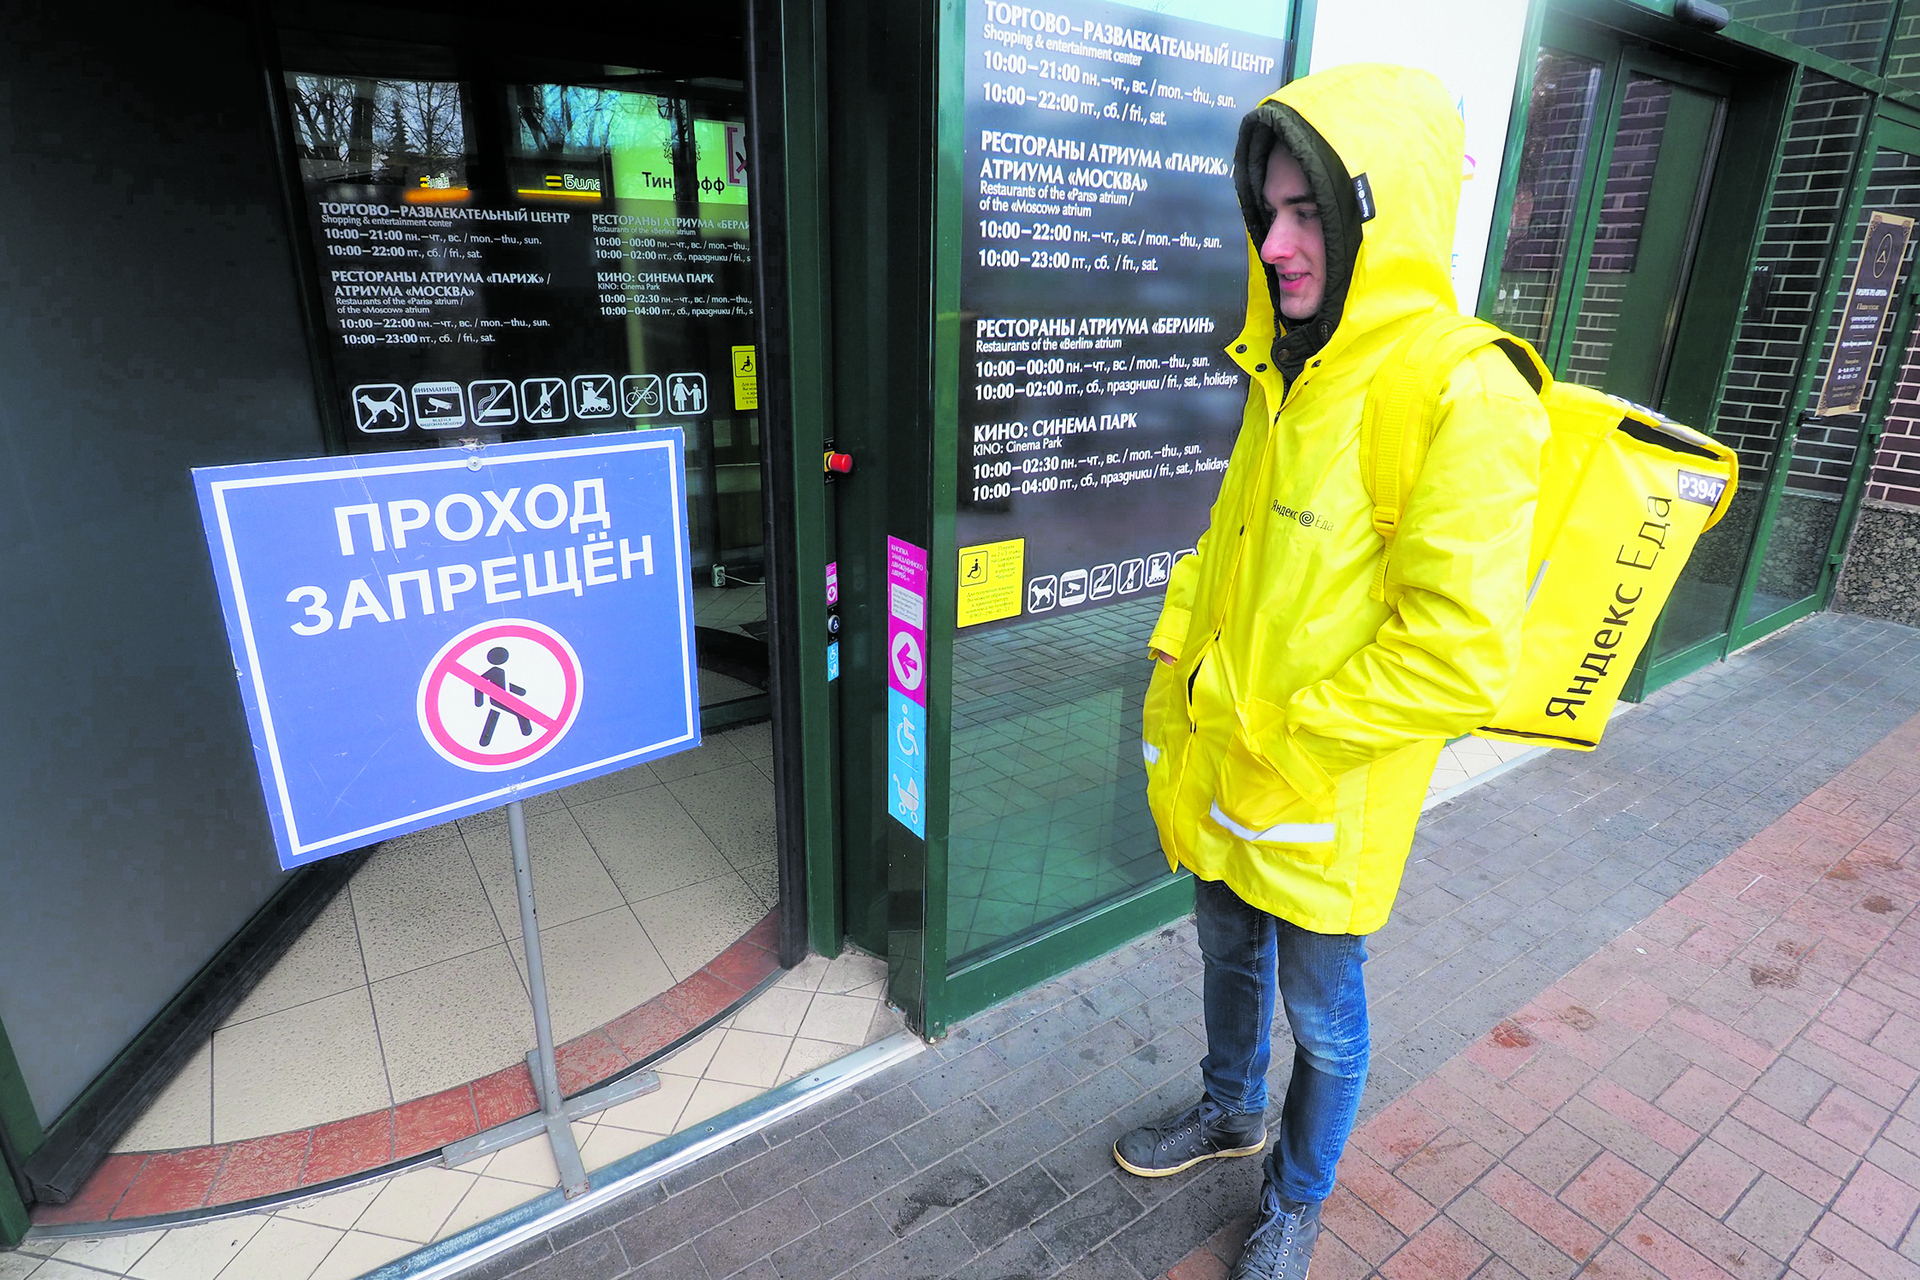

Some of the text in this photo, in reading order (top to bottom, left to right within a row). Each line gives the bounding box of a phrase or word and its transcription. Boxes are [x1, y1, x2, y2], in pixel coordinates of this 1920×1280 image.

[984, 24, 1142, 66] Shopping & entertainment center
[985, 0, 1274, 75] ТОРГОВО–РАЗВЛЕКАТЕЛЬНЫЙ ЦЕНТР
[984, 50, 1080, 83] 10:00–21:00
[1132, 80, 1148, 94] вс.
[1217, 95, 1236, 108] sun.
[983, 81, 1167, 126] 10:00–22:00 пт., сб. fri., sat.
[981, 130, 1228, 175] РЕСТОРАНЫ АТРИУМА «ПАРИЖ»
[642, 172, 725, 195] Тинфф
[980, 158, 1148, 191] АТРИУМА «МОСКВА»
[980, 180, 1036, 198] Restaurants
[1038, 185, 1049, 199] of
[1050, 185, 1065, 200] the
[1099, 191, 1127, 205] atrium
[531, 212, 570, 223] ЦЕНТР
[979, 199, 990, 211] of
[992, 199, 1009, 212] the
[1062, 203, 1092, 217] atrium
[980, 220, 1071, 241] 10:00–22:00
[1121, 233, 1136, 245] вс.
[1203, 237, 1222, 248] sun.
[688, 254, 728, 264] праздники
[979, 249, 1158, 273] 10:00–23:00 пт., сб. fri., sat.
[331, 271, 417, 282] РЕСТОРАНЫ
[420, 272, 484, 283] АТРИУМА
[334, 285, 403, 296] АТРИУМА
[597, 272, 714, 284] КИНО: СИНЕМА ПАРК
[692, 309, 730, 317] праздники
[977, 318, 1214, 338] РЕСТОРАНЫ АТРИУМА «БЕРЛИН»
[976, 340, 1030, 353] Restaurants
[1031, 338, 1042, 351] of
[1042, 338, 1058, 350] the
[1095, 337, 1122, 349] atrium
[976, 358, 1064, 377] 10:00–00:00
[1113, 360, 1127, 371] вс.
[1192, 357, 1210, 367] sun.
[975, 372, 1238, 400] 10:00–02:00 пт., сб., праздники fri., sat., holidays
[974, 412, 1138, 442] КИНО: СИНЕМА ПАРК
[973, 436, 1063, 456] KINO: Cinema Park
[973, 456, 1059, 479] 10:00–02:30
[1106, 453, 1121, 464] вс.
[1184, 445, 1202, 455] sun.
[973, 457, 1229, 501] 10:00–04:00 пт., сб., праздники fri., sat., holidays
[333, 478, 611, 556] ПРОХОД
[1271, 499, 1334, 532] Яндекс Еда
[285, 533, 654, 637] ЗАПРЕЩЁН
[1545, 495, 1673, 721] Яндекс Еда
